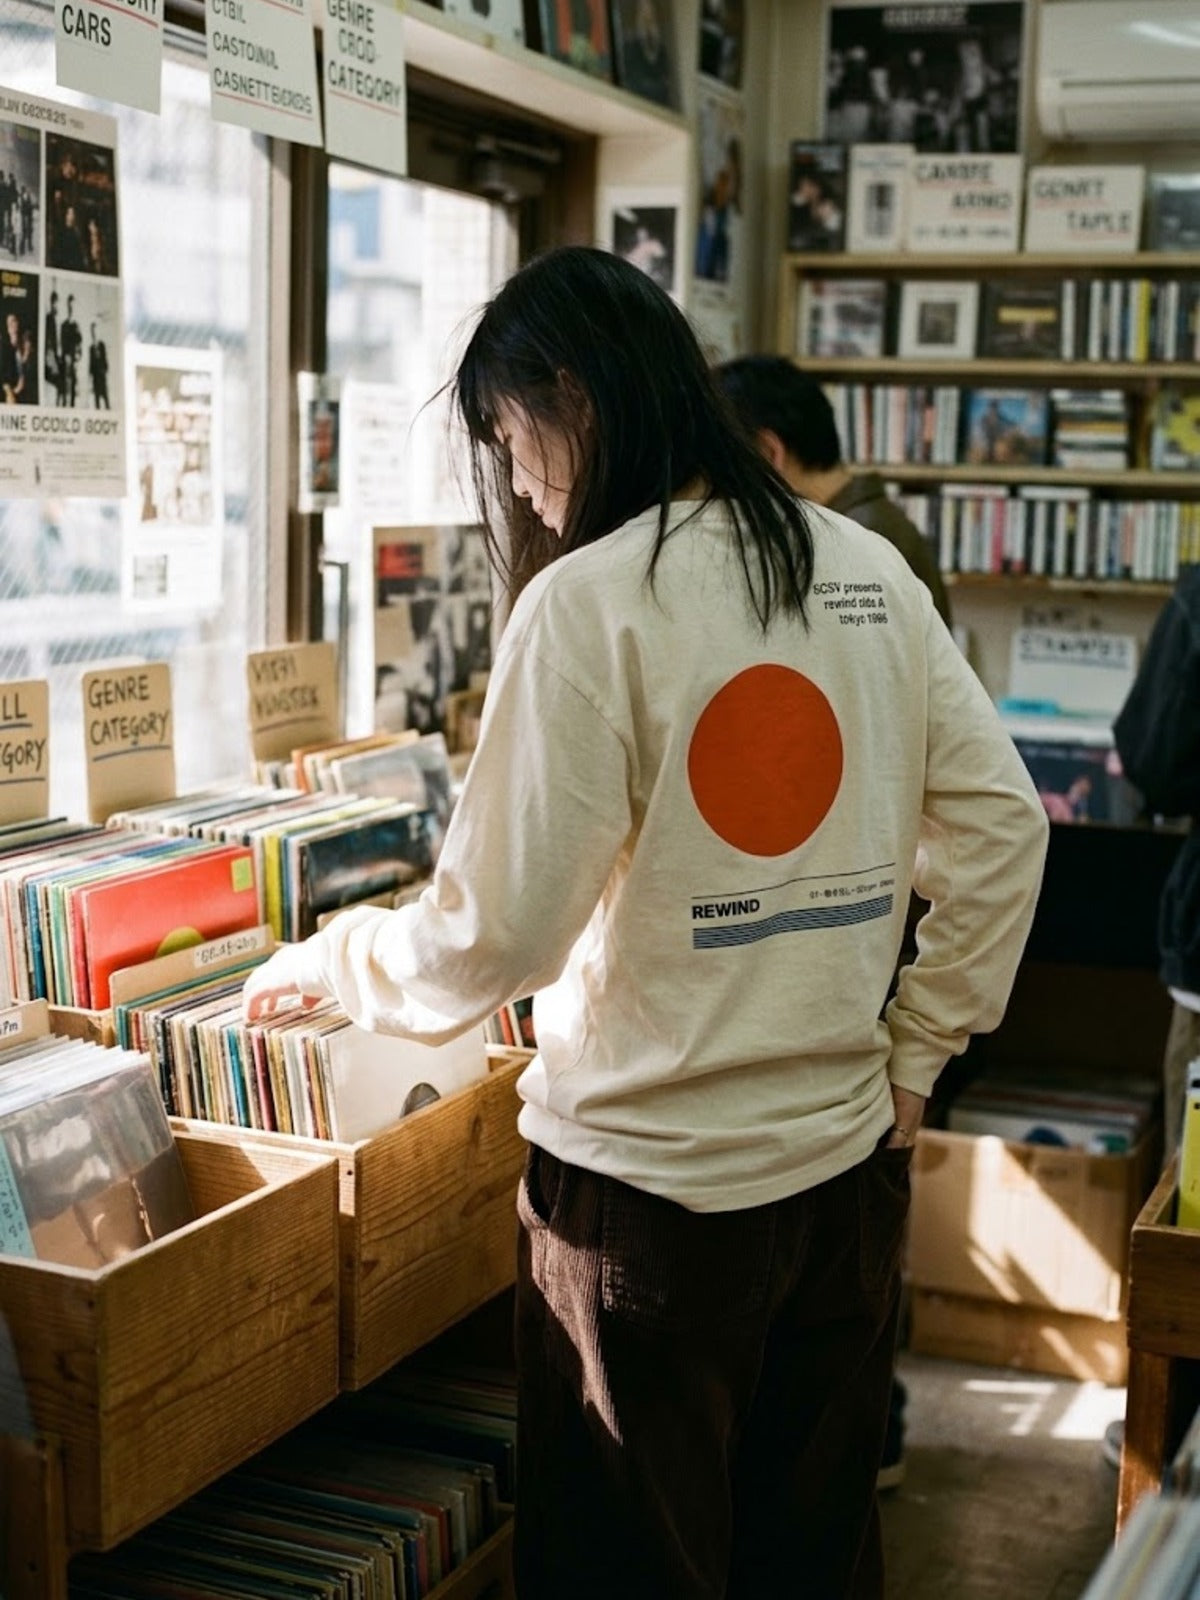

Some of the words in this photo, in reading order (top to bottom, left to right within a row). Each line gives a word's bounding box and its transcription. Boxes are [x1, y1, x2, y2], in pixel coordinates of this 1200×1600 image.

[62, 4, 111, 46] CARS
[328, 0, 374, 33] GENRE
[328, 60, 401, 108] CATEGORY
[824, 597, 857, 610] rewind
[88, 674, 150, 710] GENRE
[90, 709, 170, 746] CATEGORY
[691, 899, 761, 919] REWIND
